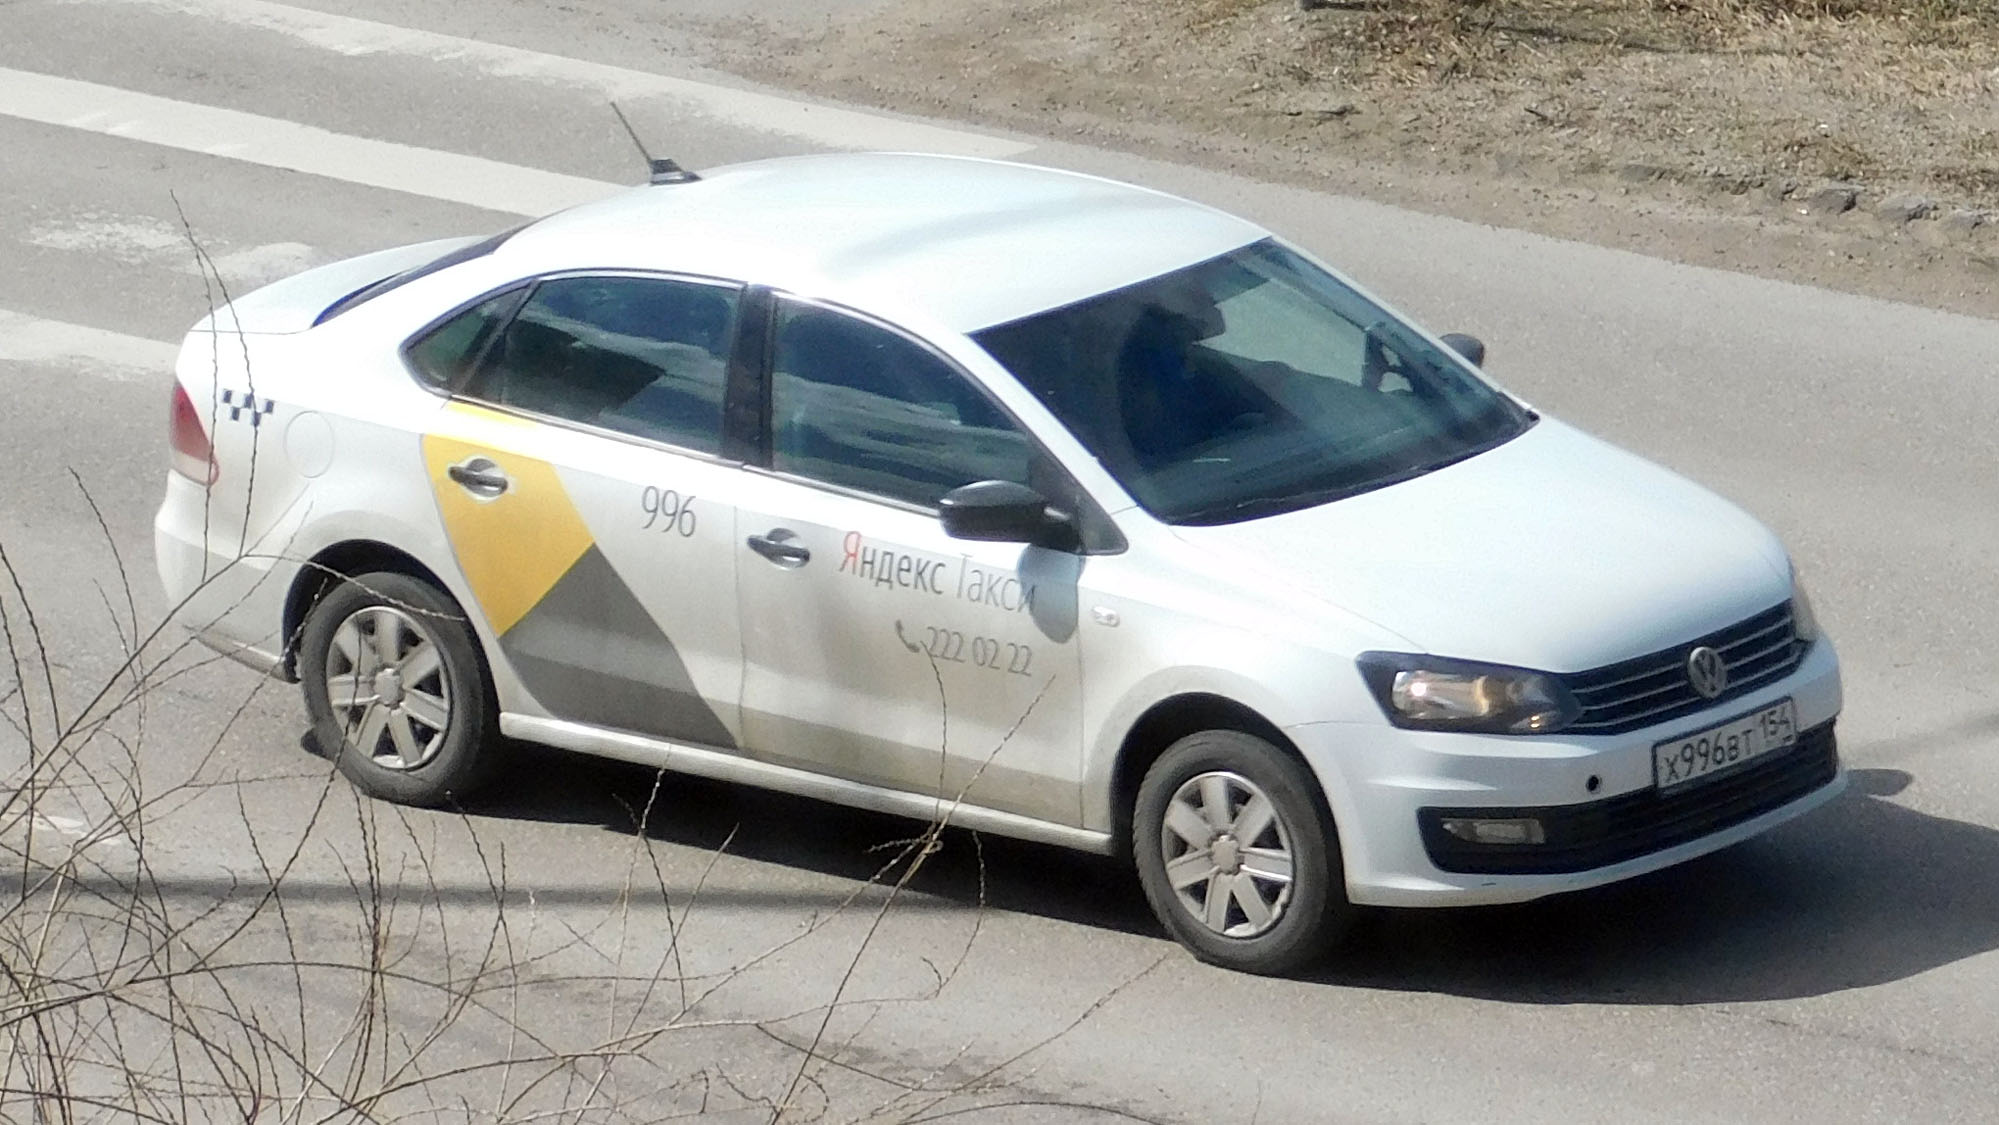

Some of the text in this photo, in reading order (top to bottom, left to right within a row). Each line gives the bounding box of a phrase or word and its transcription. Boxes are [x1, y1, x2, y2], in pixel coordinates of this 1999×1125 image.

[641, 486, 697, 538] 996
[839, 531, 1037, 613] Яндекс Такси
[925, 626, 1033, 677] 222 02 22
